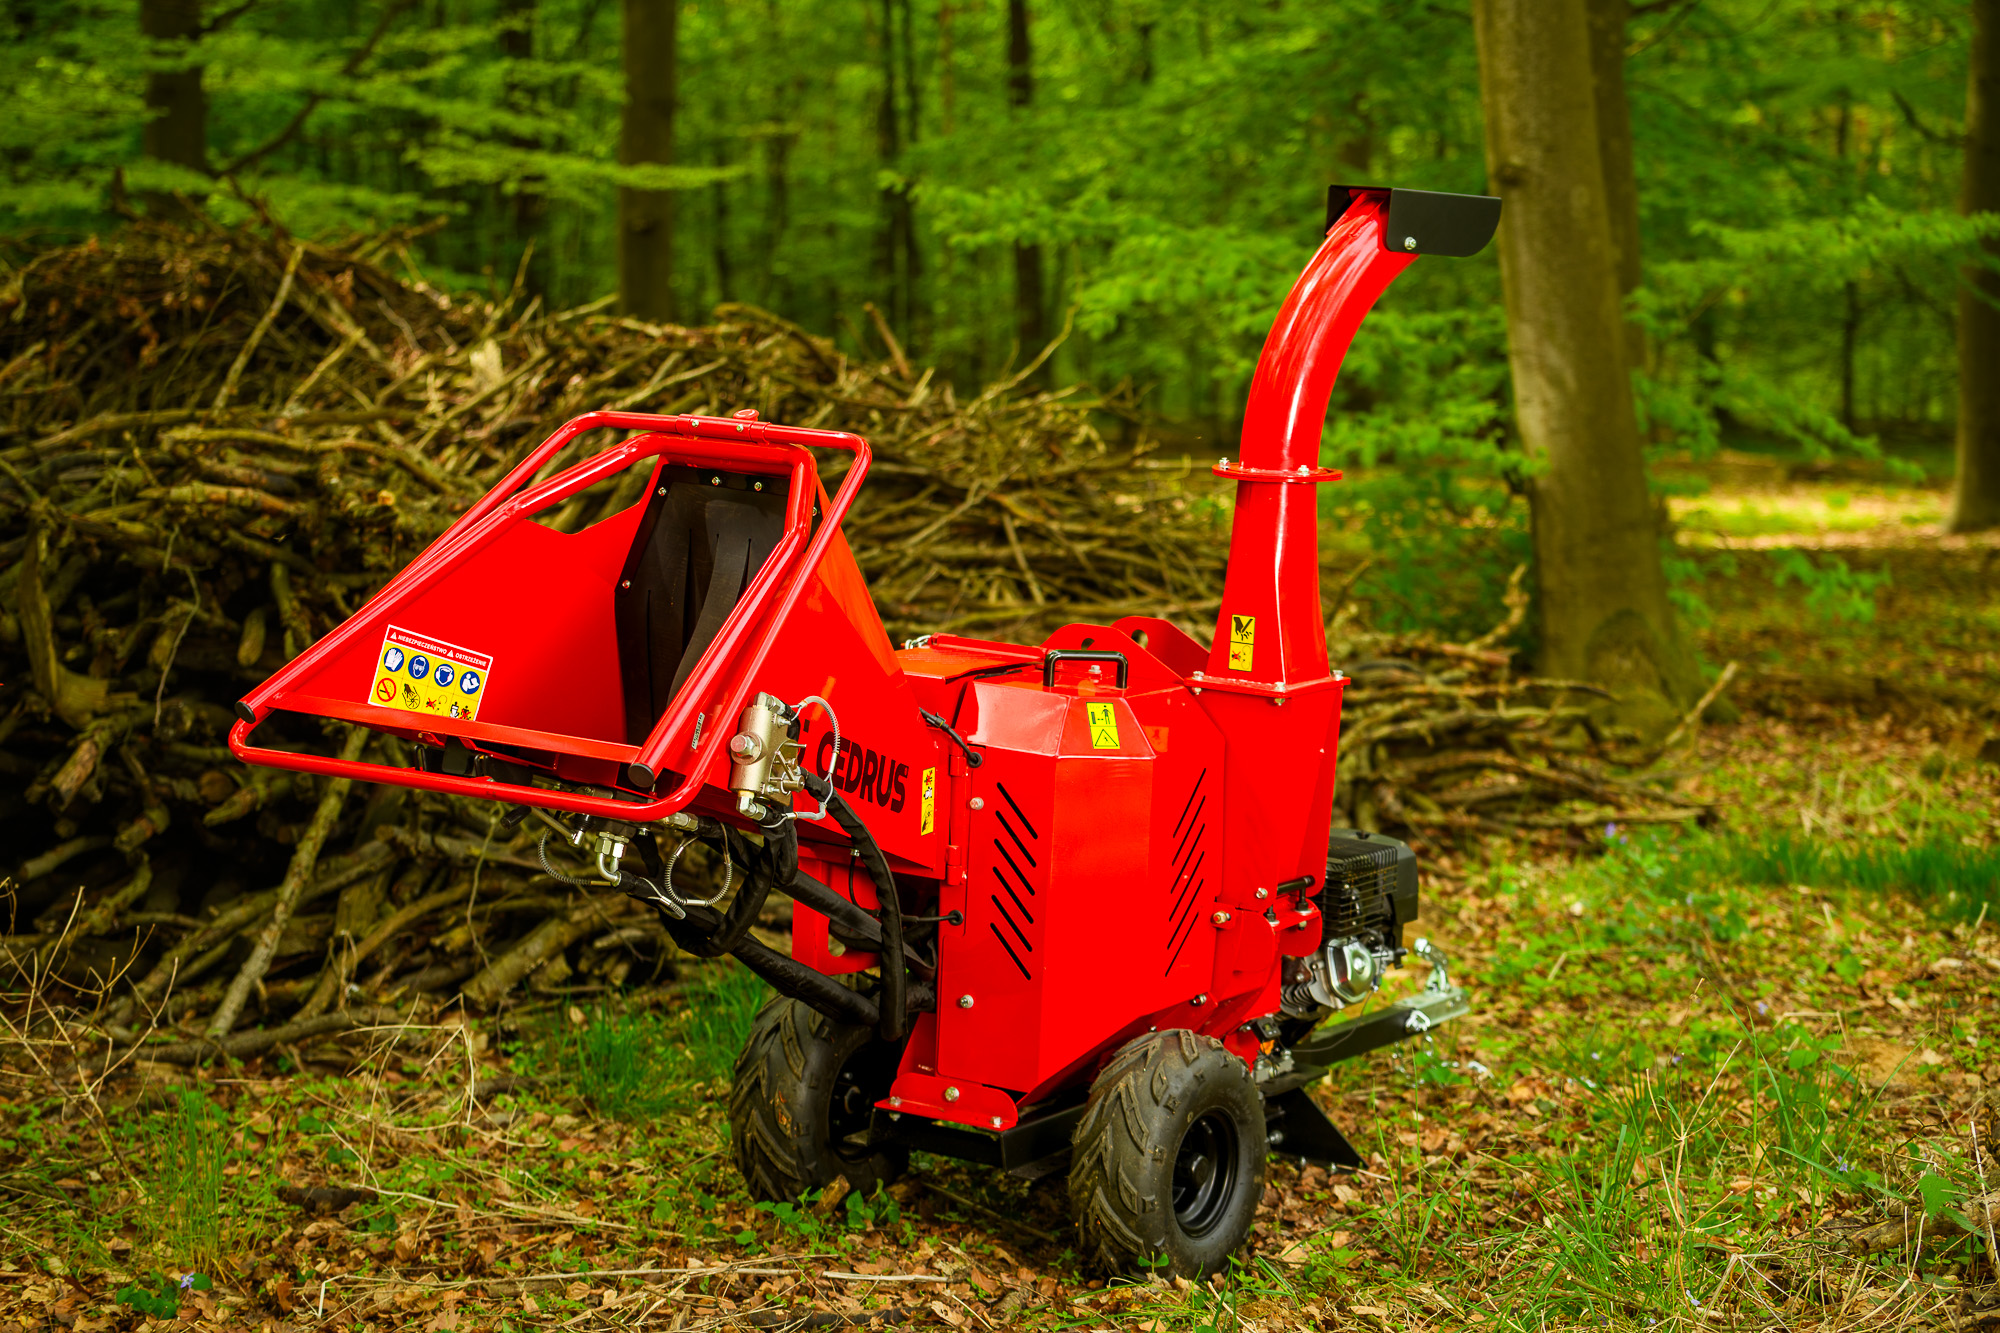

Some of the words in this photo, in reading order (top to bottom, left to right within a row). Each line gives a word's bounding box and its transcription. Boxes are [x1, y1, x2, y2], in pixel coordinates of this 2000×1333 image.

[397, 634, 447, 655] NIEBEZPIECZEŃSTWO
[455, 652, 488, 667] OSTRZEŻENIE
[816, 731, 909, 813] CEDRUS
